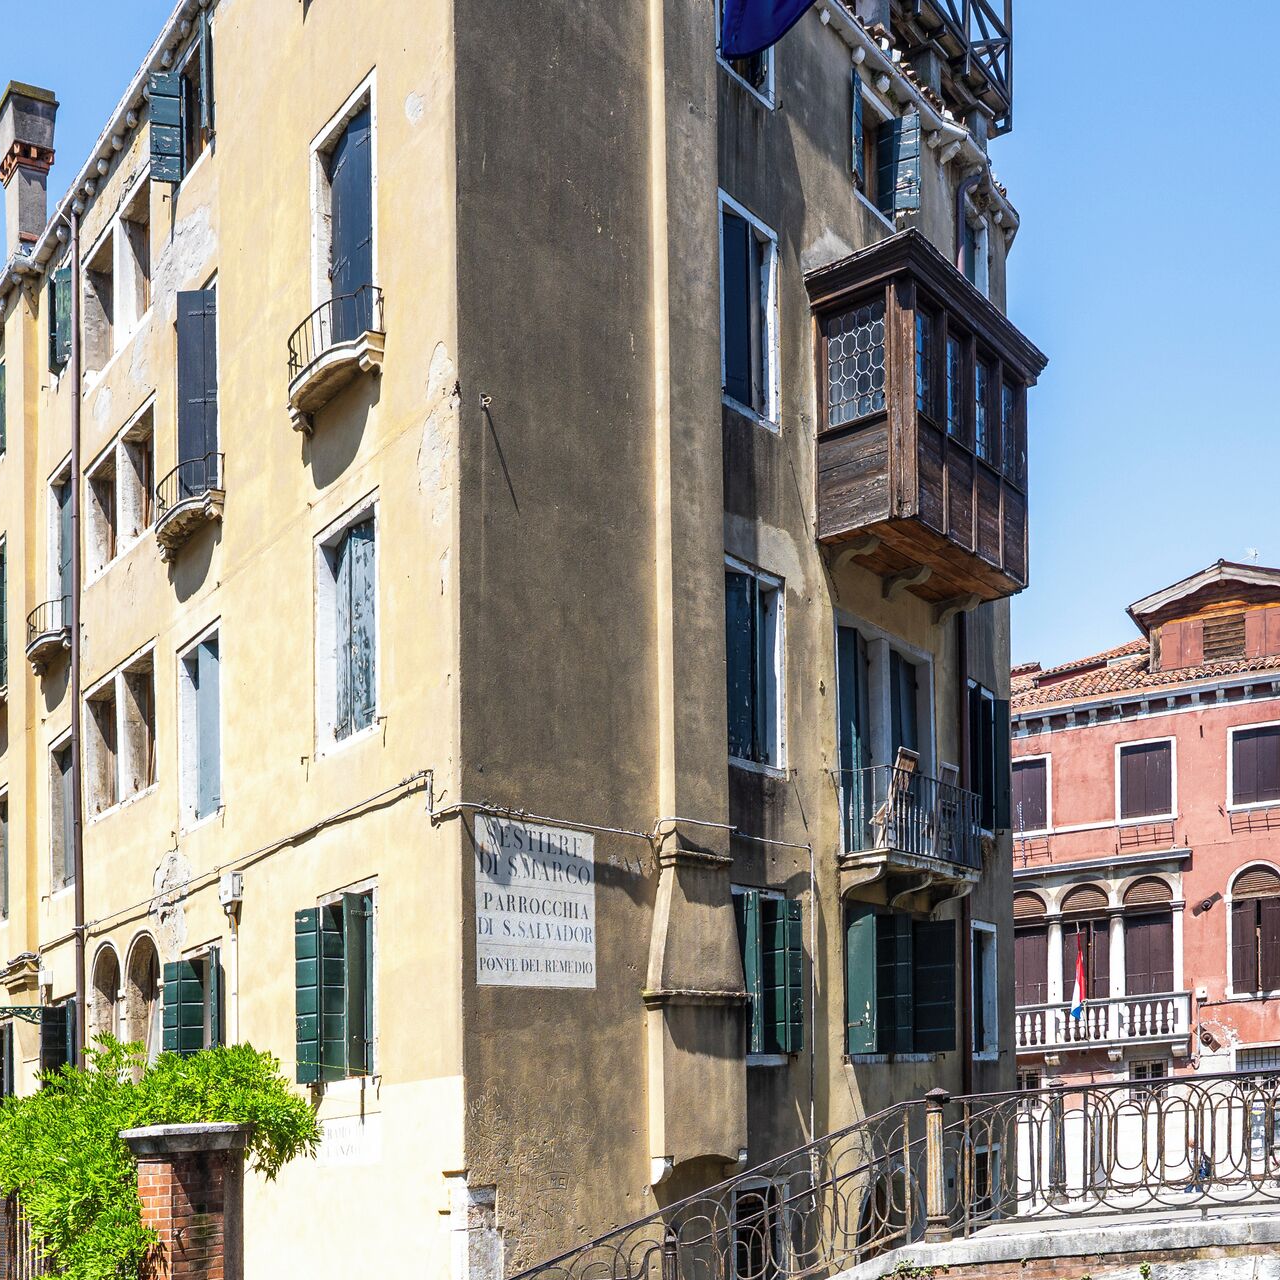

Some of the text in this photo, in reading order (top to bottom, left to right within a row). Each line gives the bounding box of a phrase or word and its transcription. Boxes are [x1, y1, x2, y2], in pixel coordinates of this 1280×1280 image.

[486, 823, 583, 859] SESTIERE
[479, 851, 499, 875] DI
[483, 892, 589, 920] PARROCCHIA
[478, 917, 493, 936] DI
[479, 957, 593, 974] PONTE DEL REMEDIO
